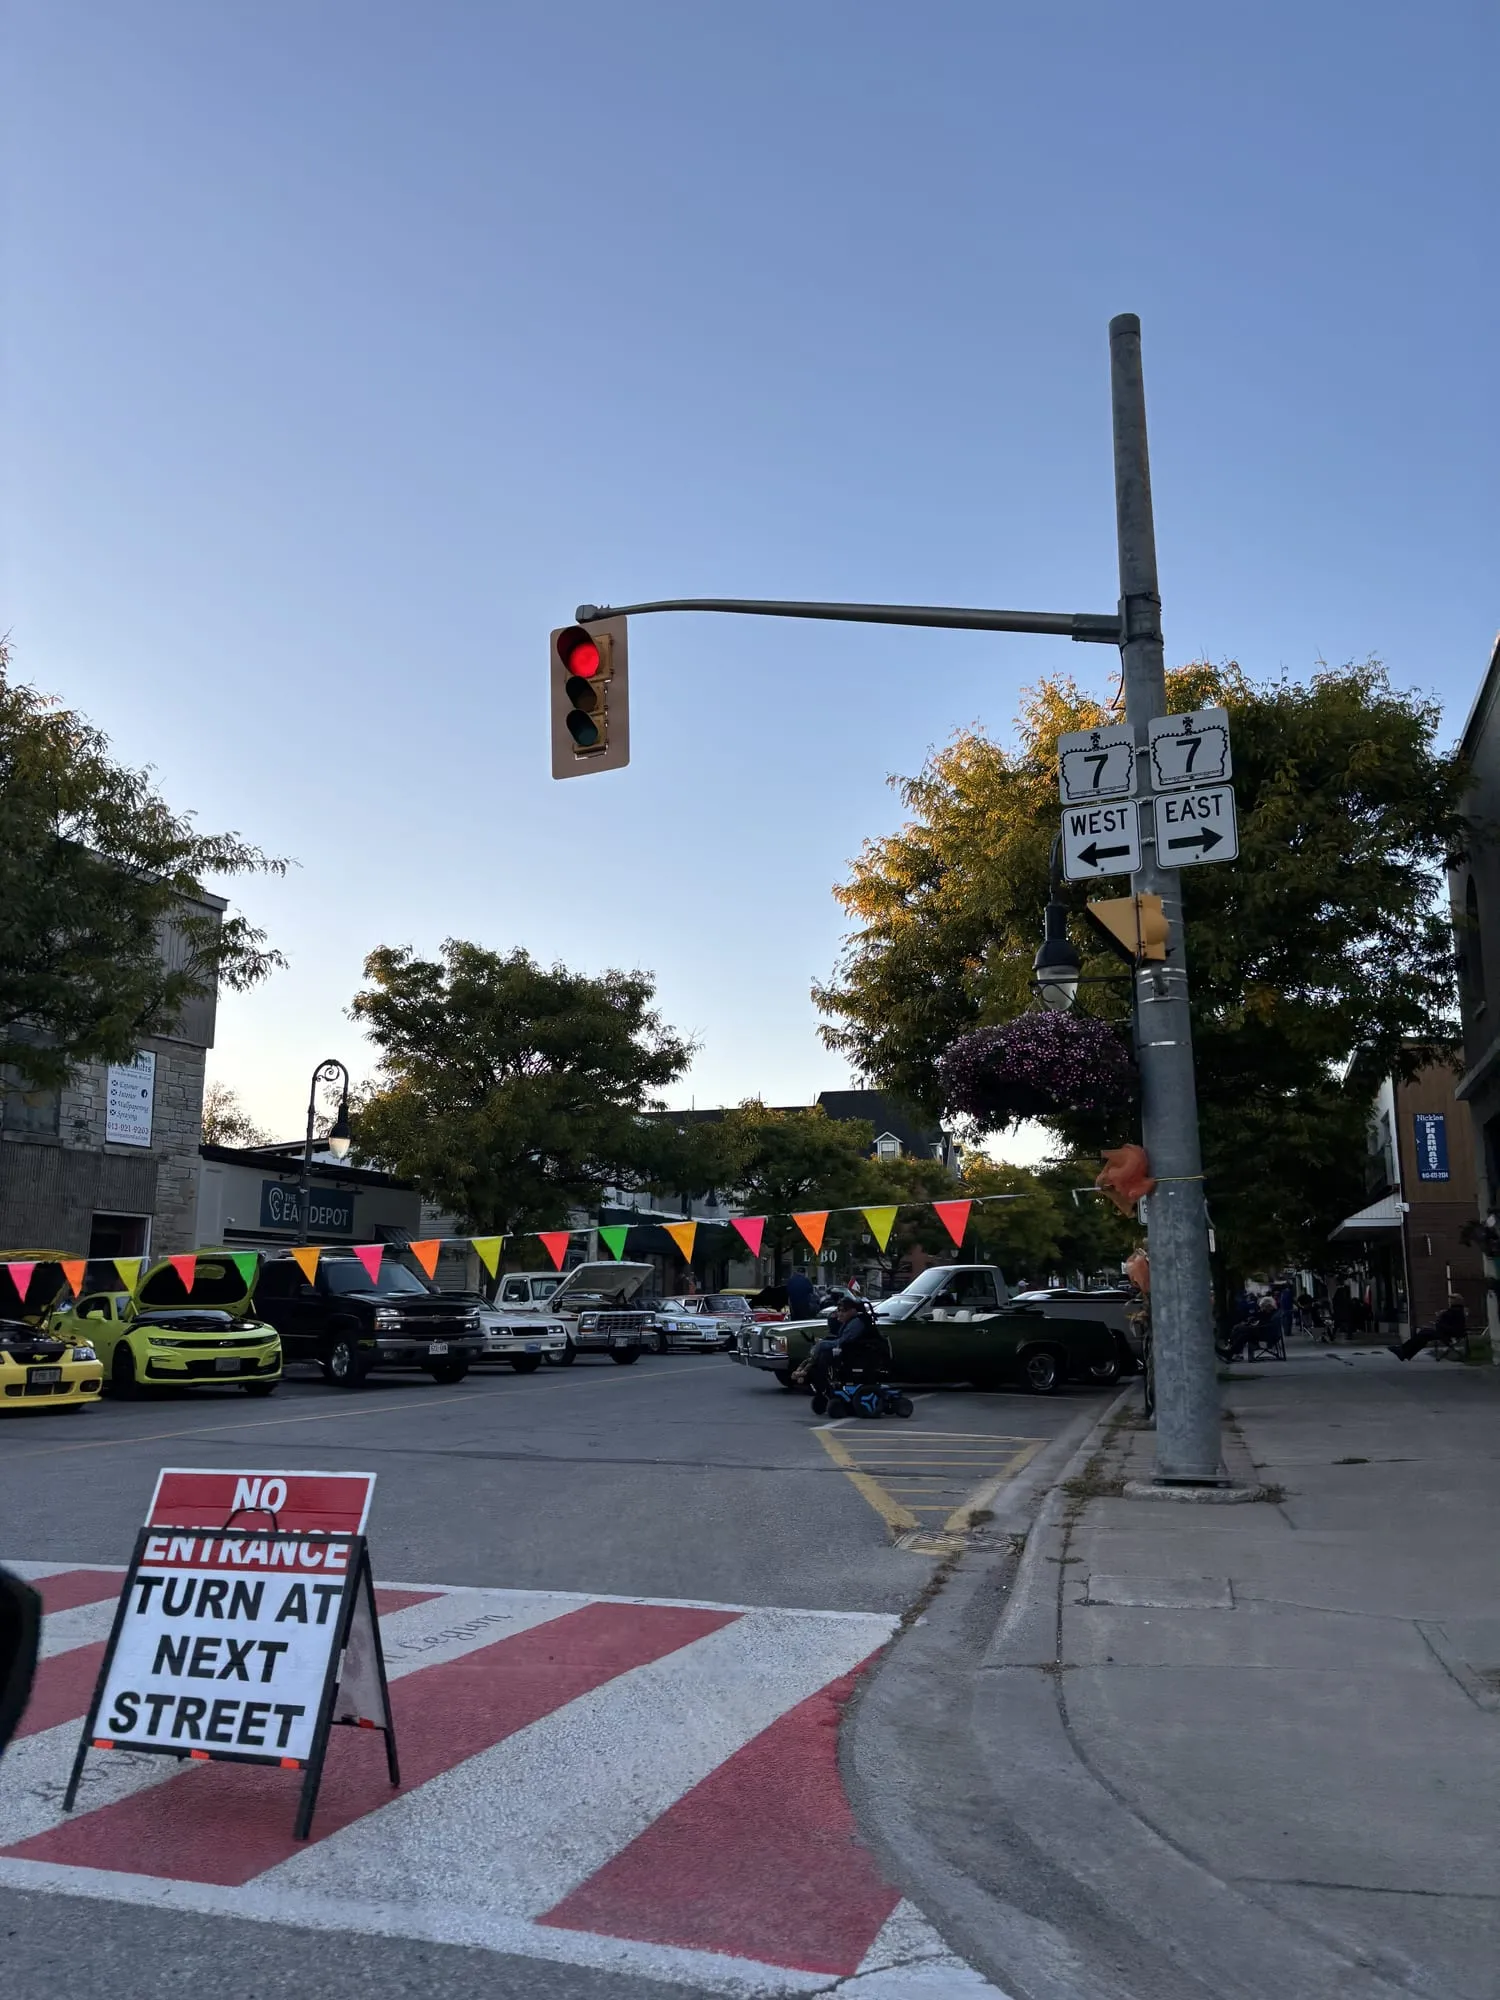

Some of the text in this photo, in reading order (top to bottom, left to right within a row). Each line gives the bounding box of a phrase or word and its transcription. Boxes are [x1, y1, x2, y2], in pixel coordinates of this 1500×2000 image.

[1084, 754, 1108, 788] 7
[1176, 737, 1202, 773] 7
[1071, 808, 1128, 837] WEST
[1165, 794, 1223, 823] EAST
[1425, 1122, 1438, 1170] PHARMACY
[282, 1203, 349, 1226] EA DEPOT
[284, 1192, 297, 1203] THE
[803, 1248, 838, 1263] LBO
[231, 1477, 288, 1514] NO
[143, 1524, 353, 1569] ENTRANCE
[135, 1575, 345, 1625] TURN AT
[151, 1634, 289, 1683] NEXT
[108, 1691, 306, 1749] STREET
